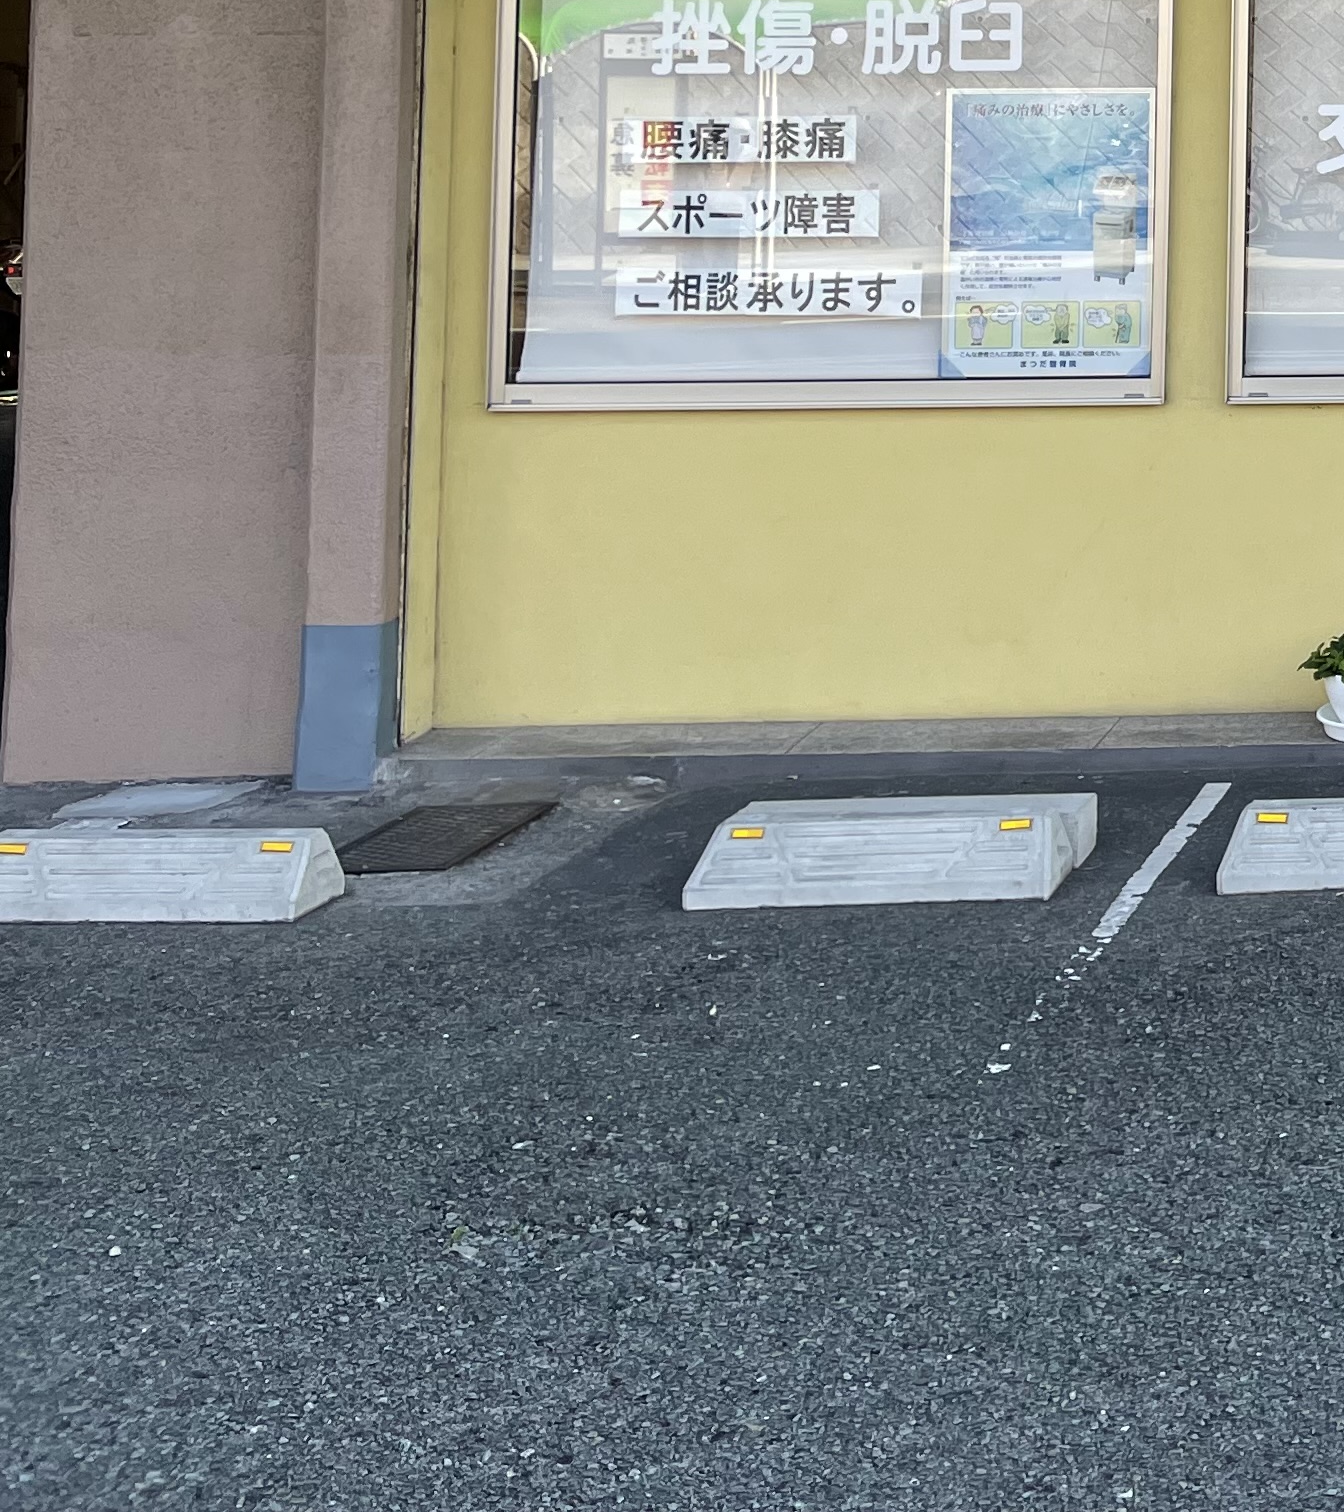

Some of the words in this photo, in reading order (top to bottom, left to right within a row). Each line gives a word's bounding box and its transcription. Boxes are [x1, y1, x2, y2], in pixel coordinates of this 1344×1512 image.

[640, 117, 846, 160] 腰痛・膝痛
[637, 192, 856, 235] スポーツ障害
[634, 269, 916, 314] ご相談承ります。
